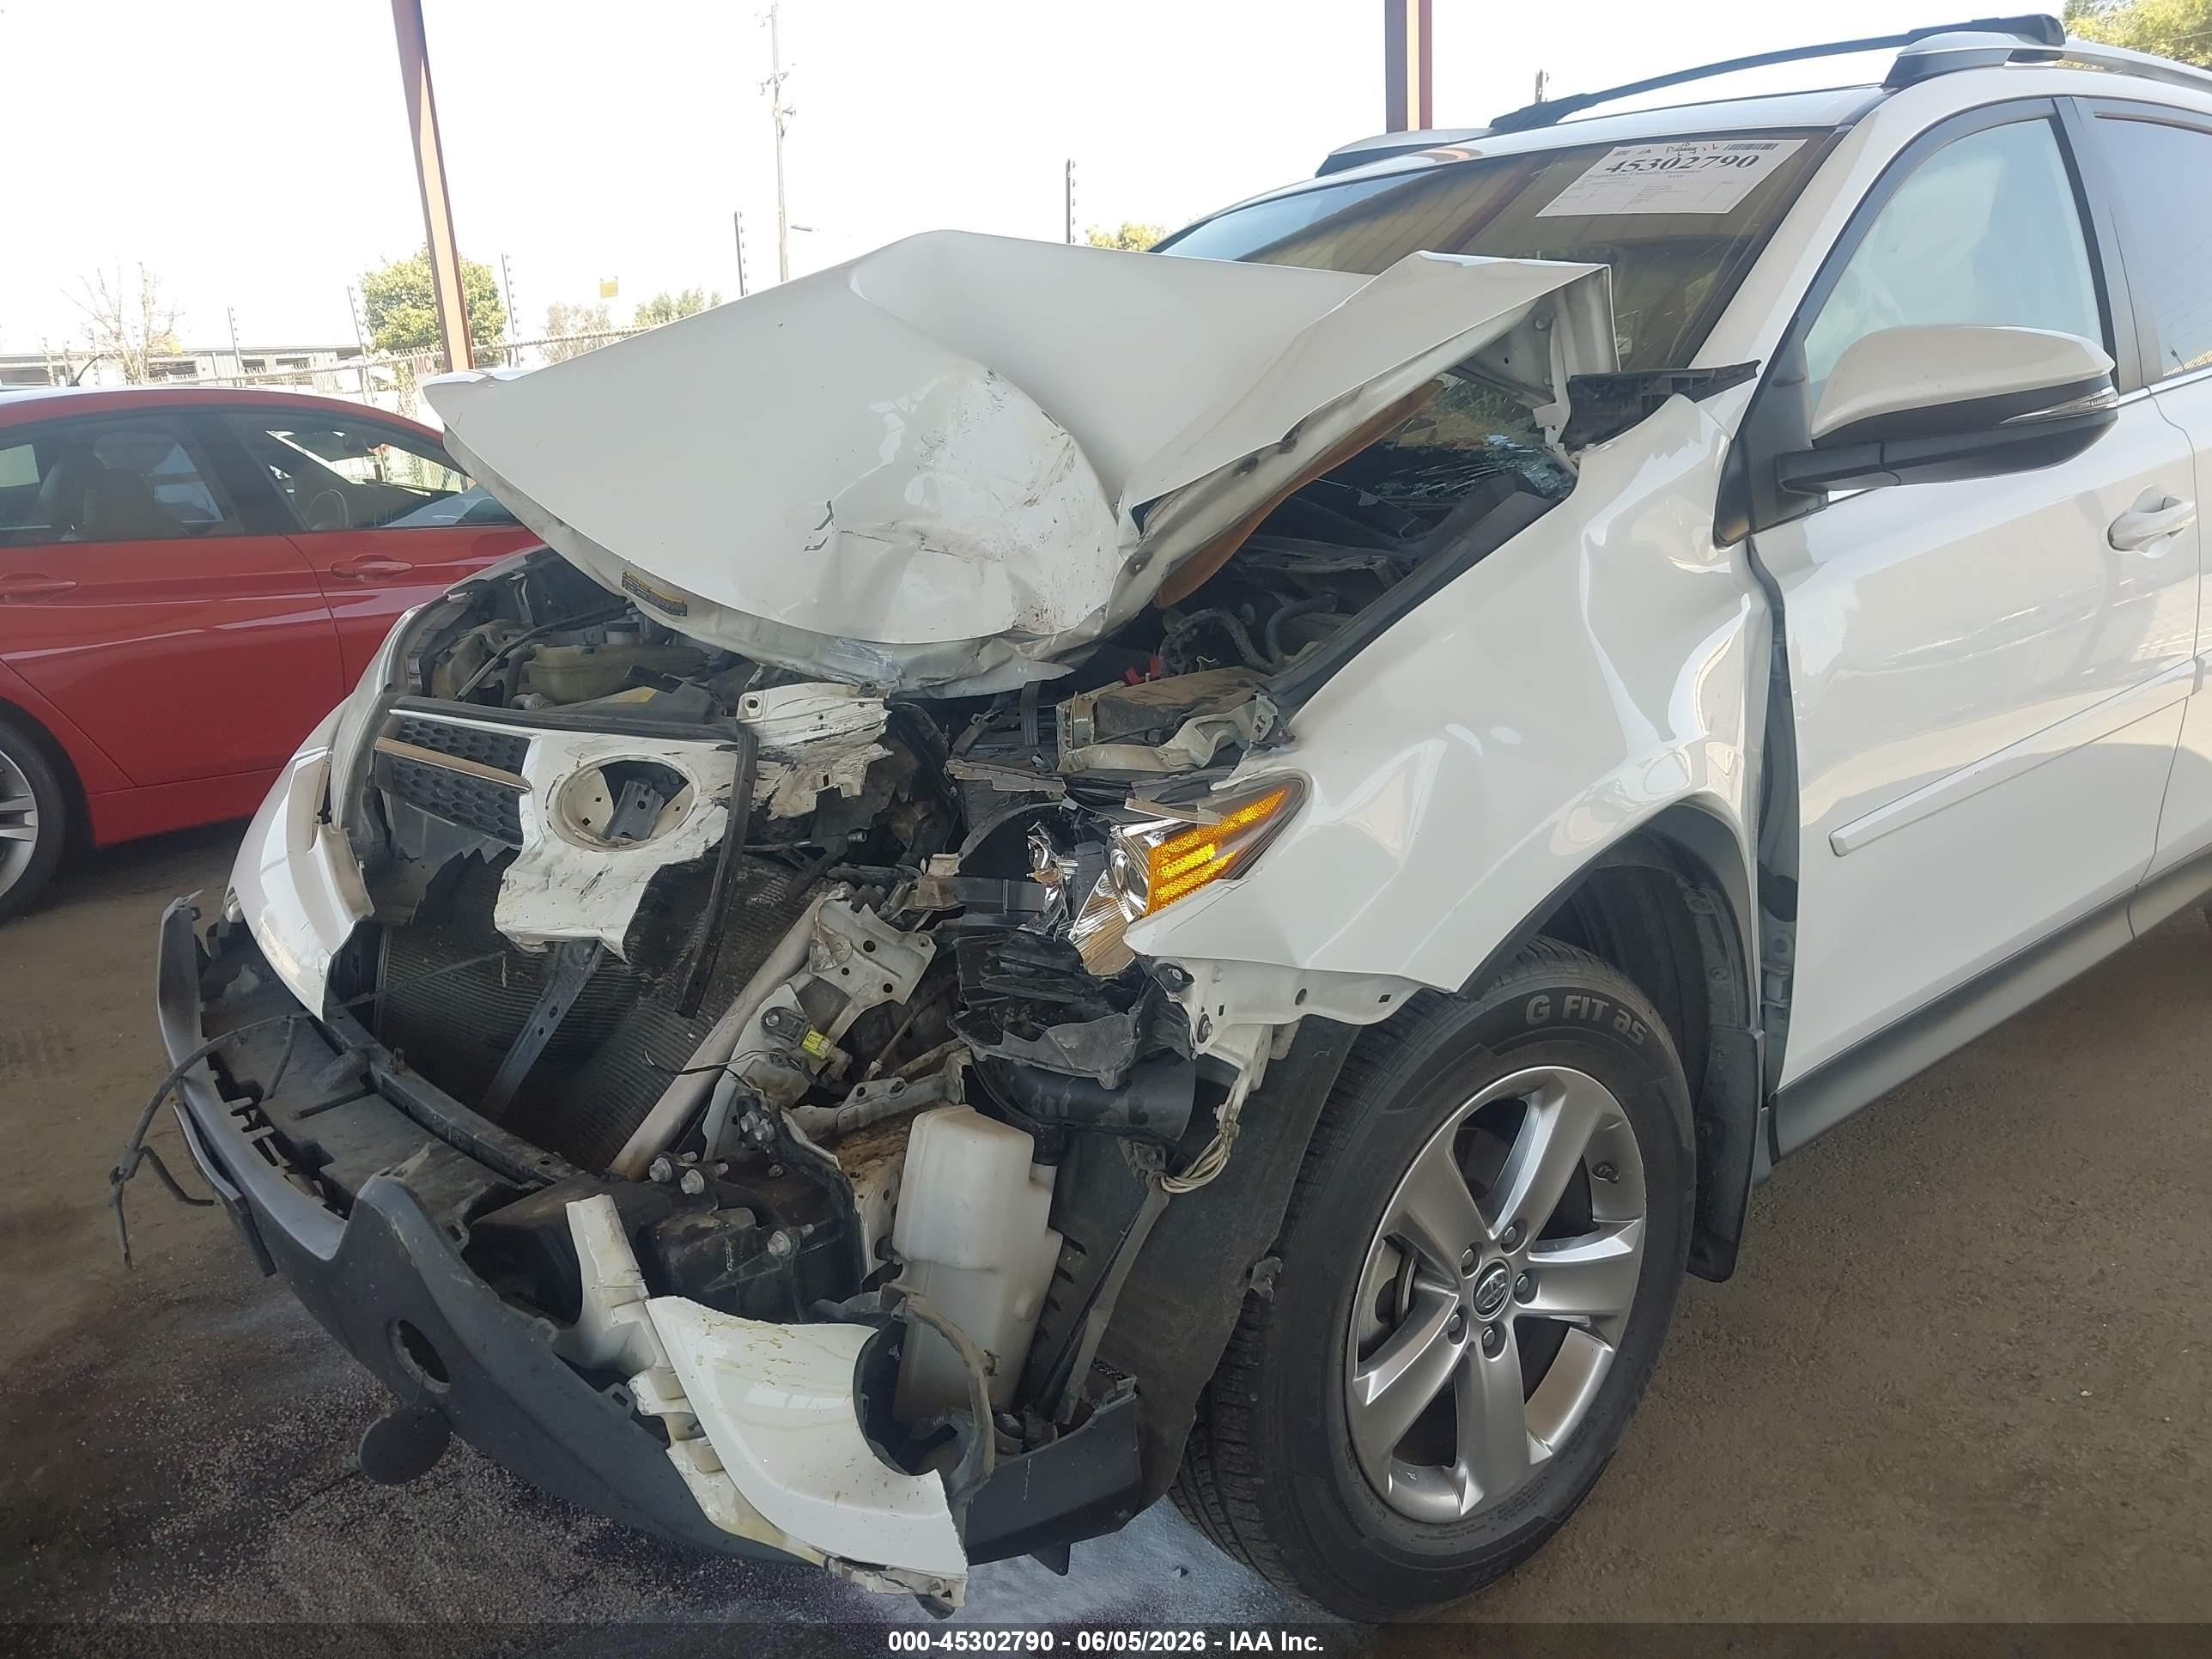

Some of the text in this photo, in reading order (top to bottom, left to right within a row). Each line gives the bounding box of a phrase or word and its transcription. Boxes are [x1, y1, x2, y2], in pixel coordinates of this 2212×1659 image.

[1605, 155, 1760, 173] 45302790
[1525, 994, 1551, 1025] G
[1561, 994, 1609, 1021] FIT
